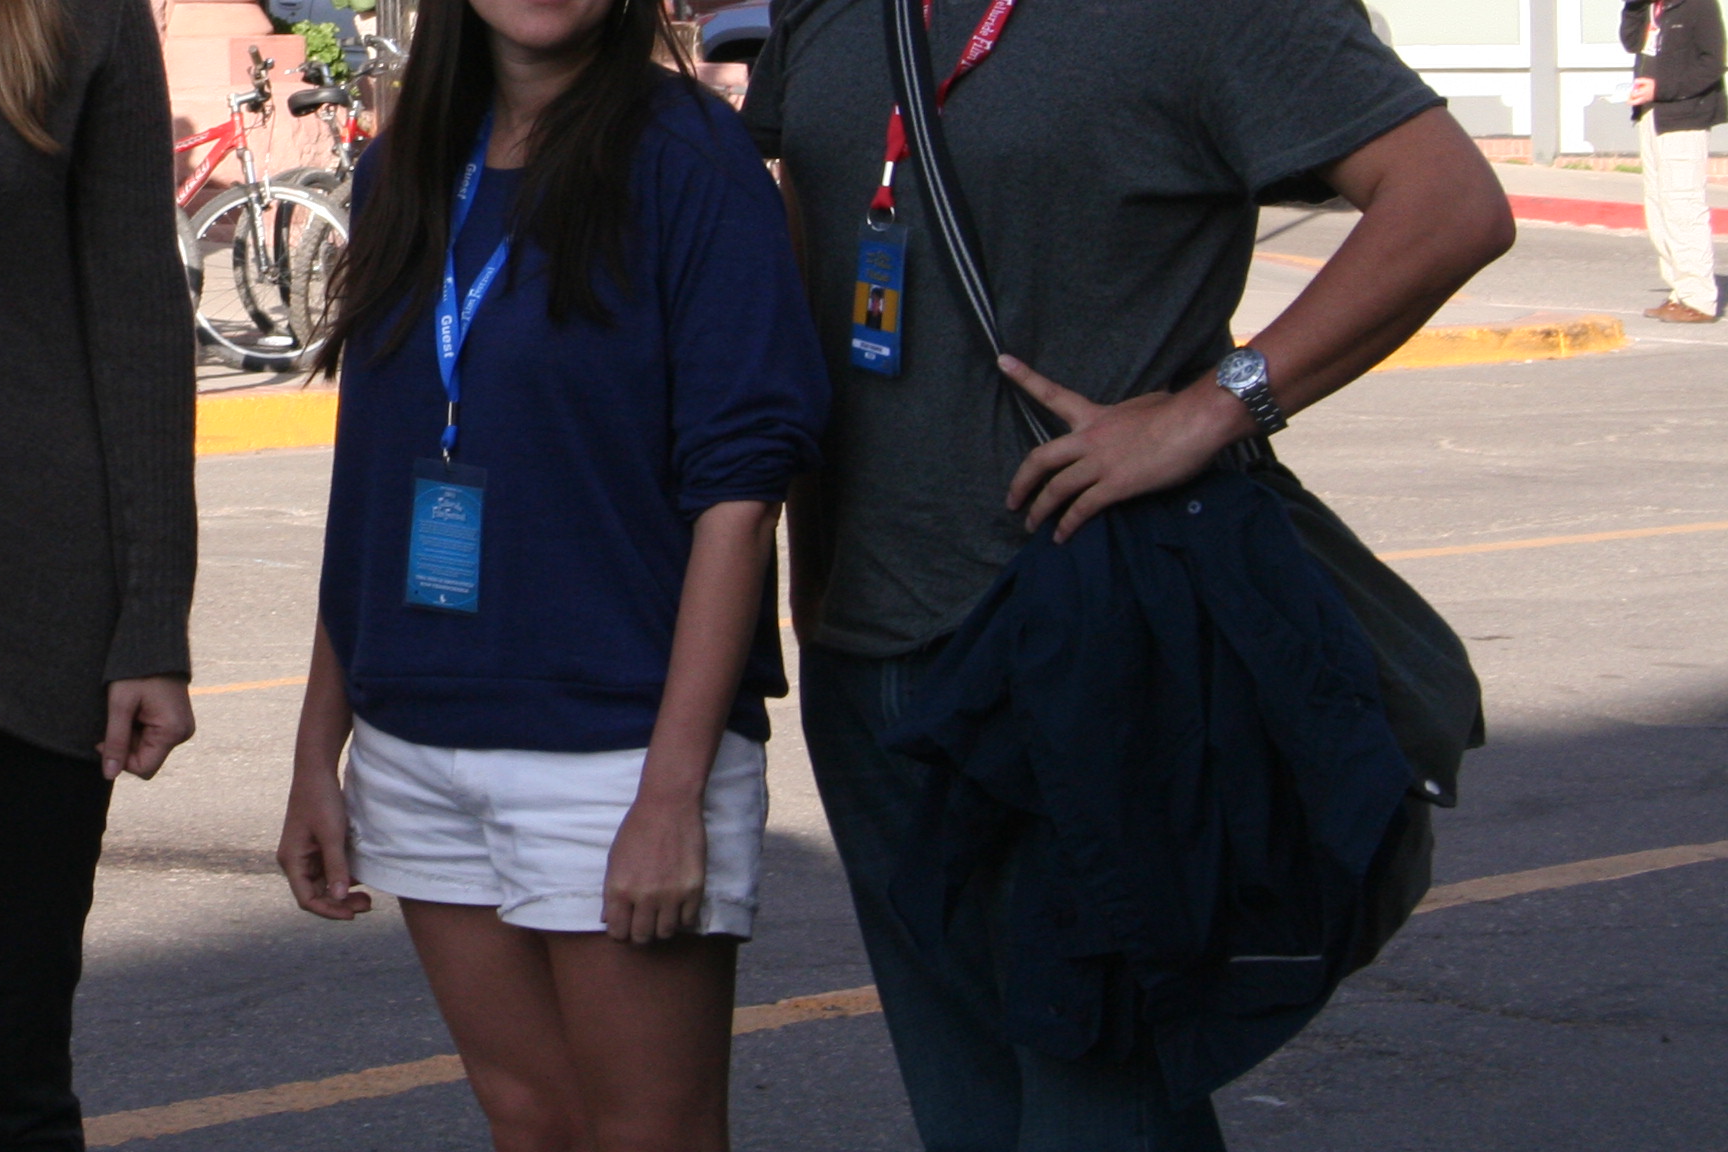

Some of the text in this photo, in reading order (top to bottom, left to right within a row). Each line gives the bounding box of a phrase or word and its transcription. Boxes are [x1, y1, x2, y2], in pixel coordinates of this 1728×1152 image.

[969, 34, 994, 68] Film
[456, 163, 477, 200] Guest
[441, 314, 455, 359] Guest
